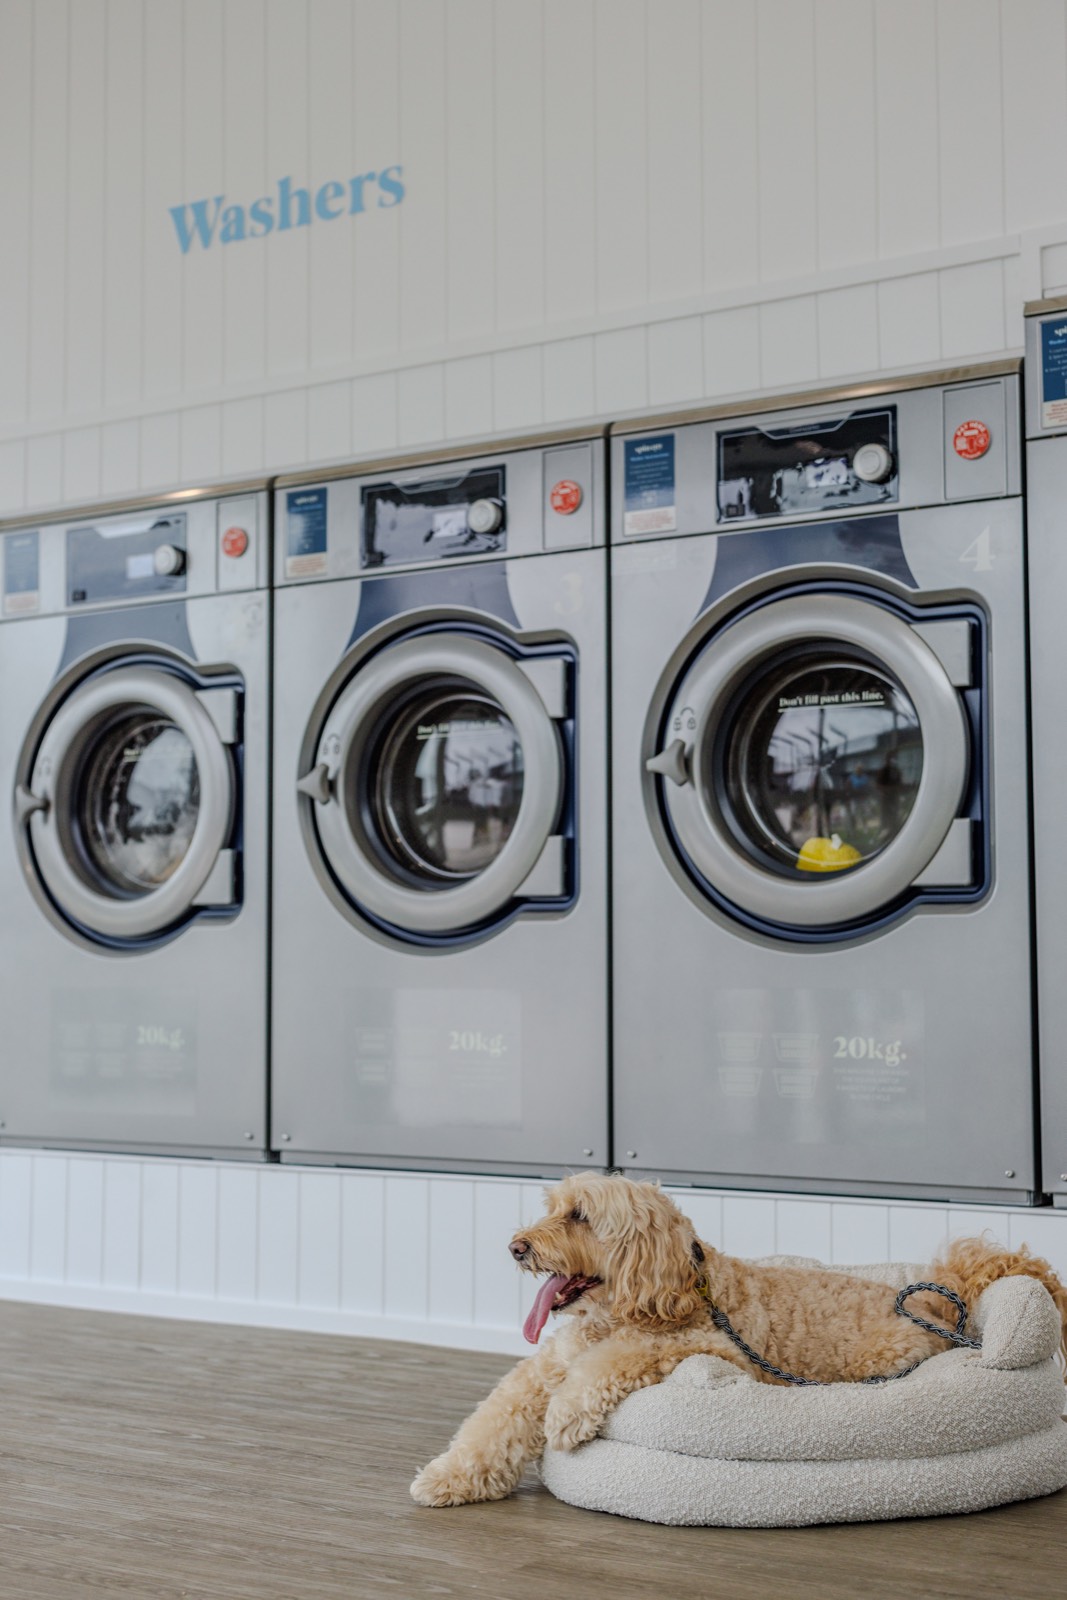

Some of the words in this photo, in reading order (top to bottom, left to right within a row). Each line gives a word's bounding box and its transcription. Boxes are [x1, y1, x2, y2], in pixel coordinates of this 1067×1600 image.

[169, 164, 406, 255] Washers
[958, 524, 997, 571] 4
[779, 696, 803, 707] Don't
[805, 694, 819, 705] fill
[820, 694, 839, 706] past
[841, 692, 860, 703] this
[862, 690, 884, 701] line.
[448, 1030, 508, 1058] 20kg.
[833, 1036, 907, 1067] 20kg.
